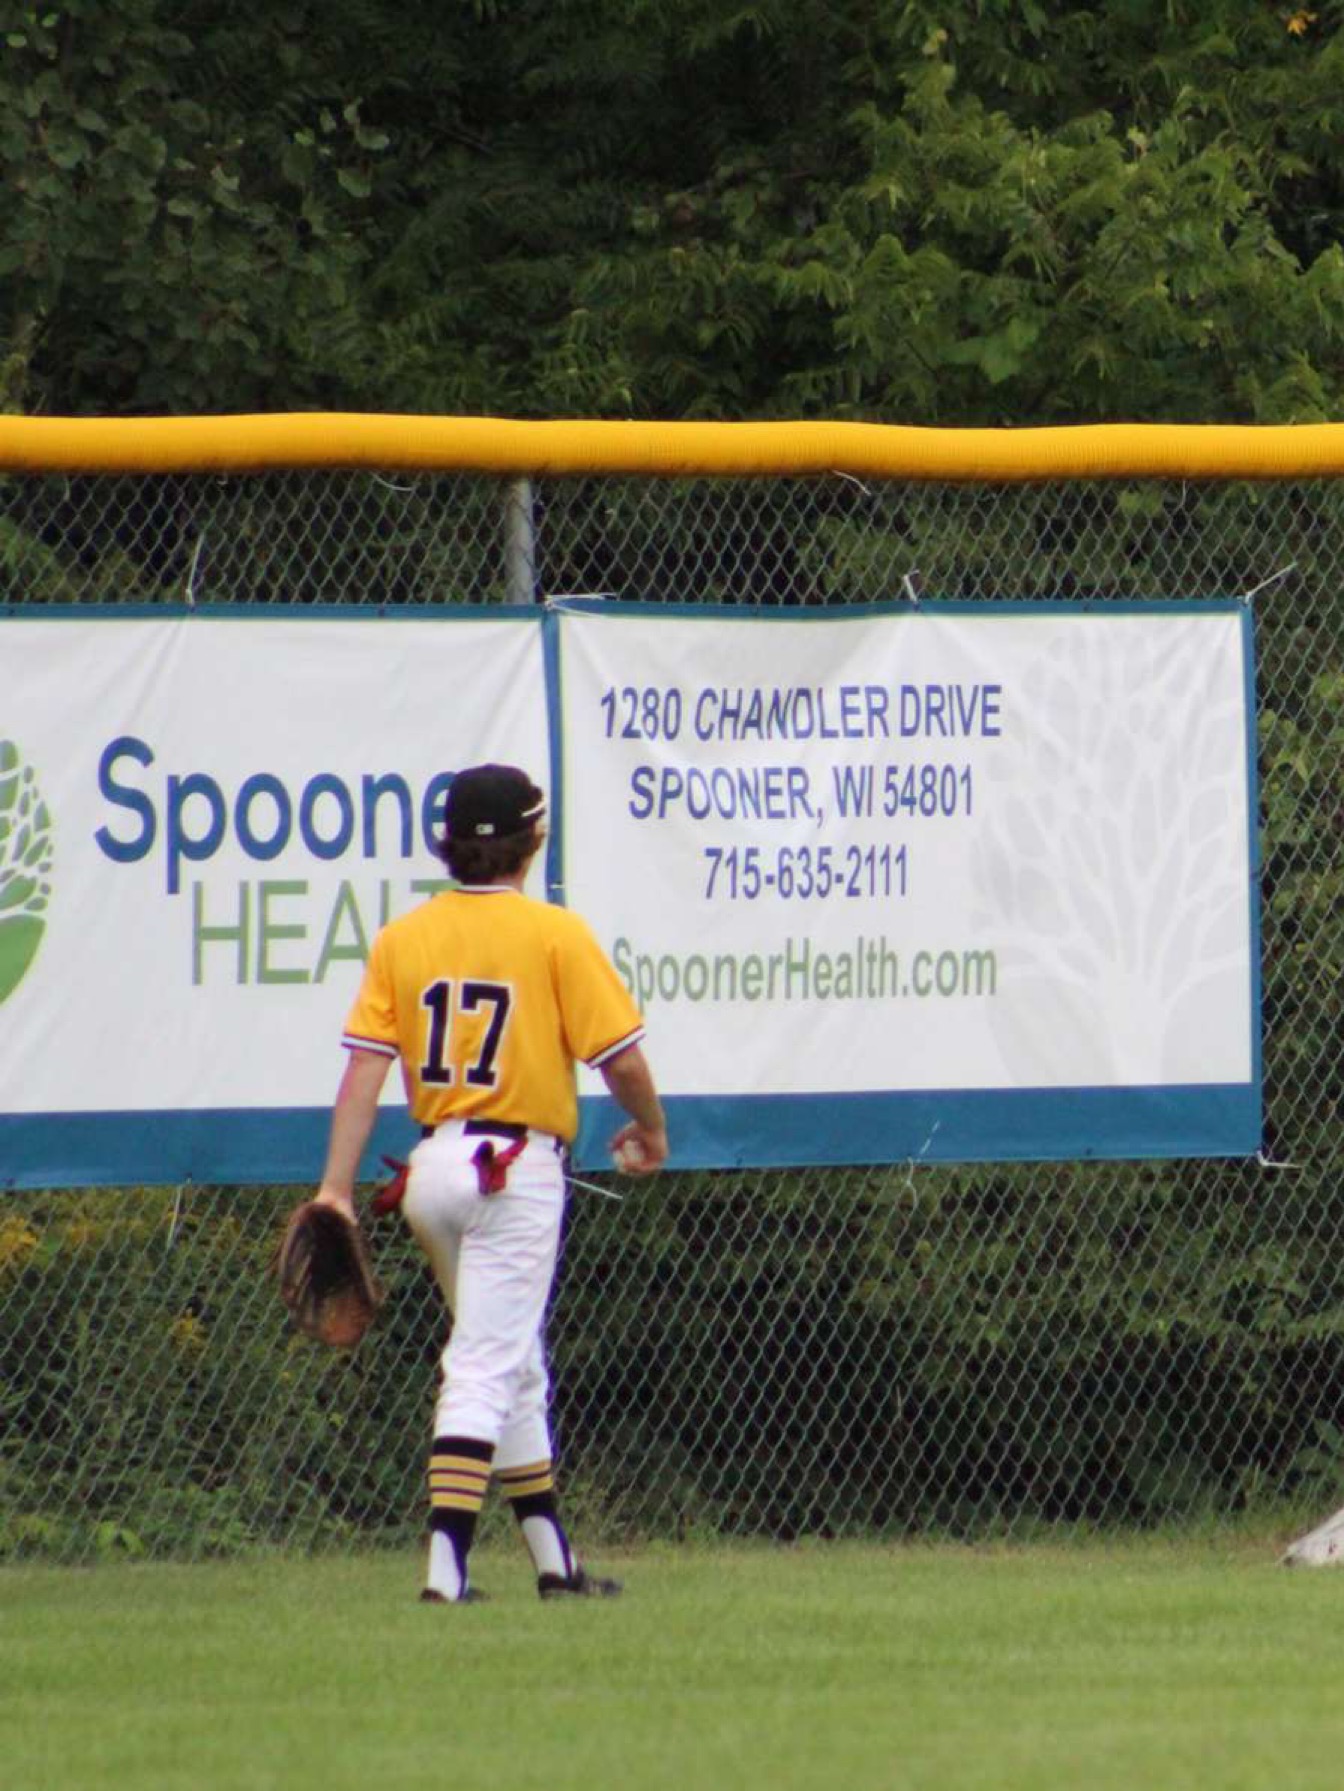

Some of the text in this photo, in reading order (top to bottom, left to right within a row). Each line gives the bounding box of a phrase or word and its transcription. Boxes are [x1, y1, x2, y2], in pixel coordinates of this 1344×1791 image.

[600, 684, 1002, 741] 1280 CHANDLER DRIVE
[94, 736, 458, 894] Spoone
[628, 763, 973, 828] SPOONER, WI 54801
[704, 844, 907, 900] 715-635-2111
[612, 936, 997, 1017] SpoonerHealth.com
[420, 979, 515, 1088] 17
